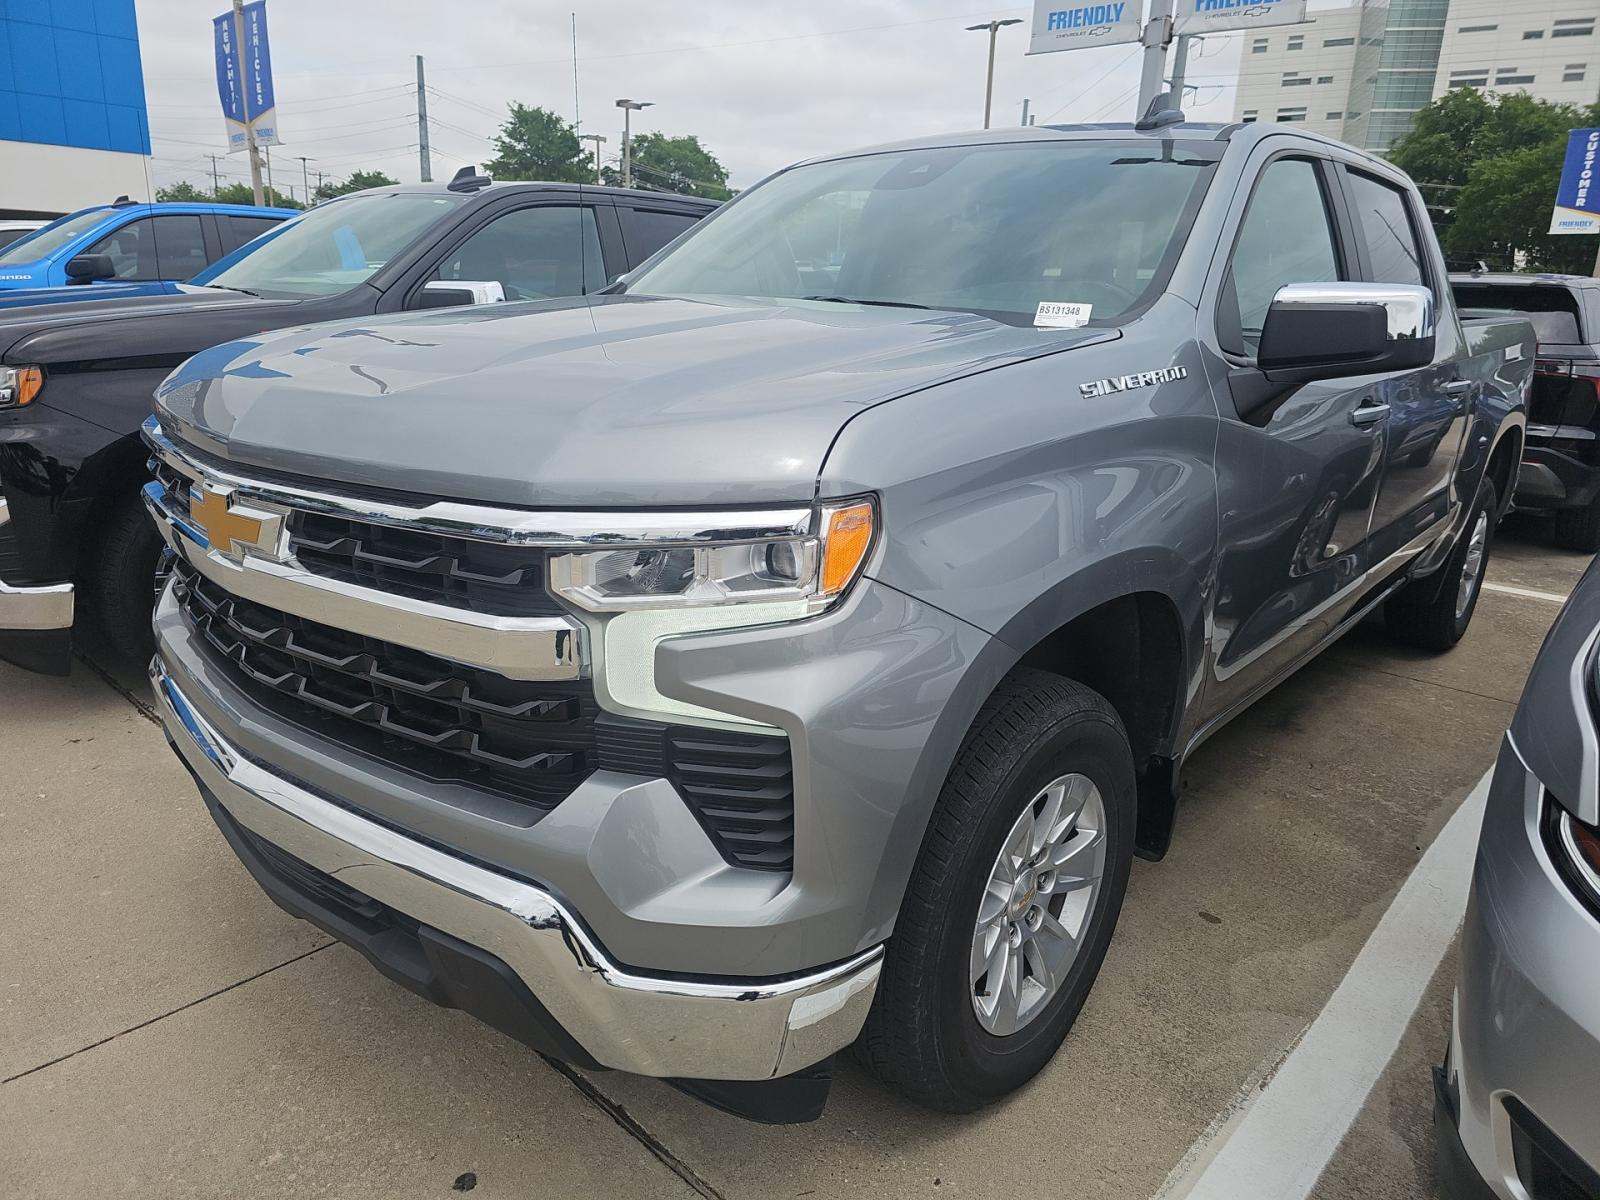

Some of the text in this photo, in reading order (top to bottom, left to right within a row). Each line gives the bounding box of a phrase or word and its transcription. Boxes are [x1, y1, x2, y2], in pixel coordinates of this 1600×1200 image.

[1048, 2, 1125, 31] FRIENDLY
[222, 20, 231, 55] NEW
[251, 10, 263, 106] VEHICLES
[1575, 132, 1600, 207] CUSTOMER
[1038, 305, 1081, 316] BS131348
[1079, 366, 1188, 399] SILVERADO
